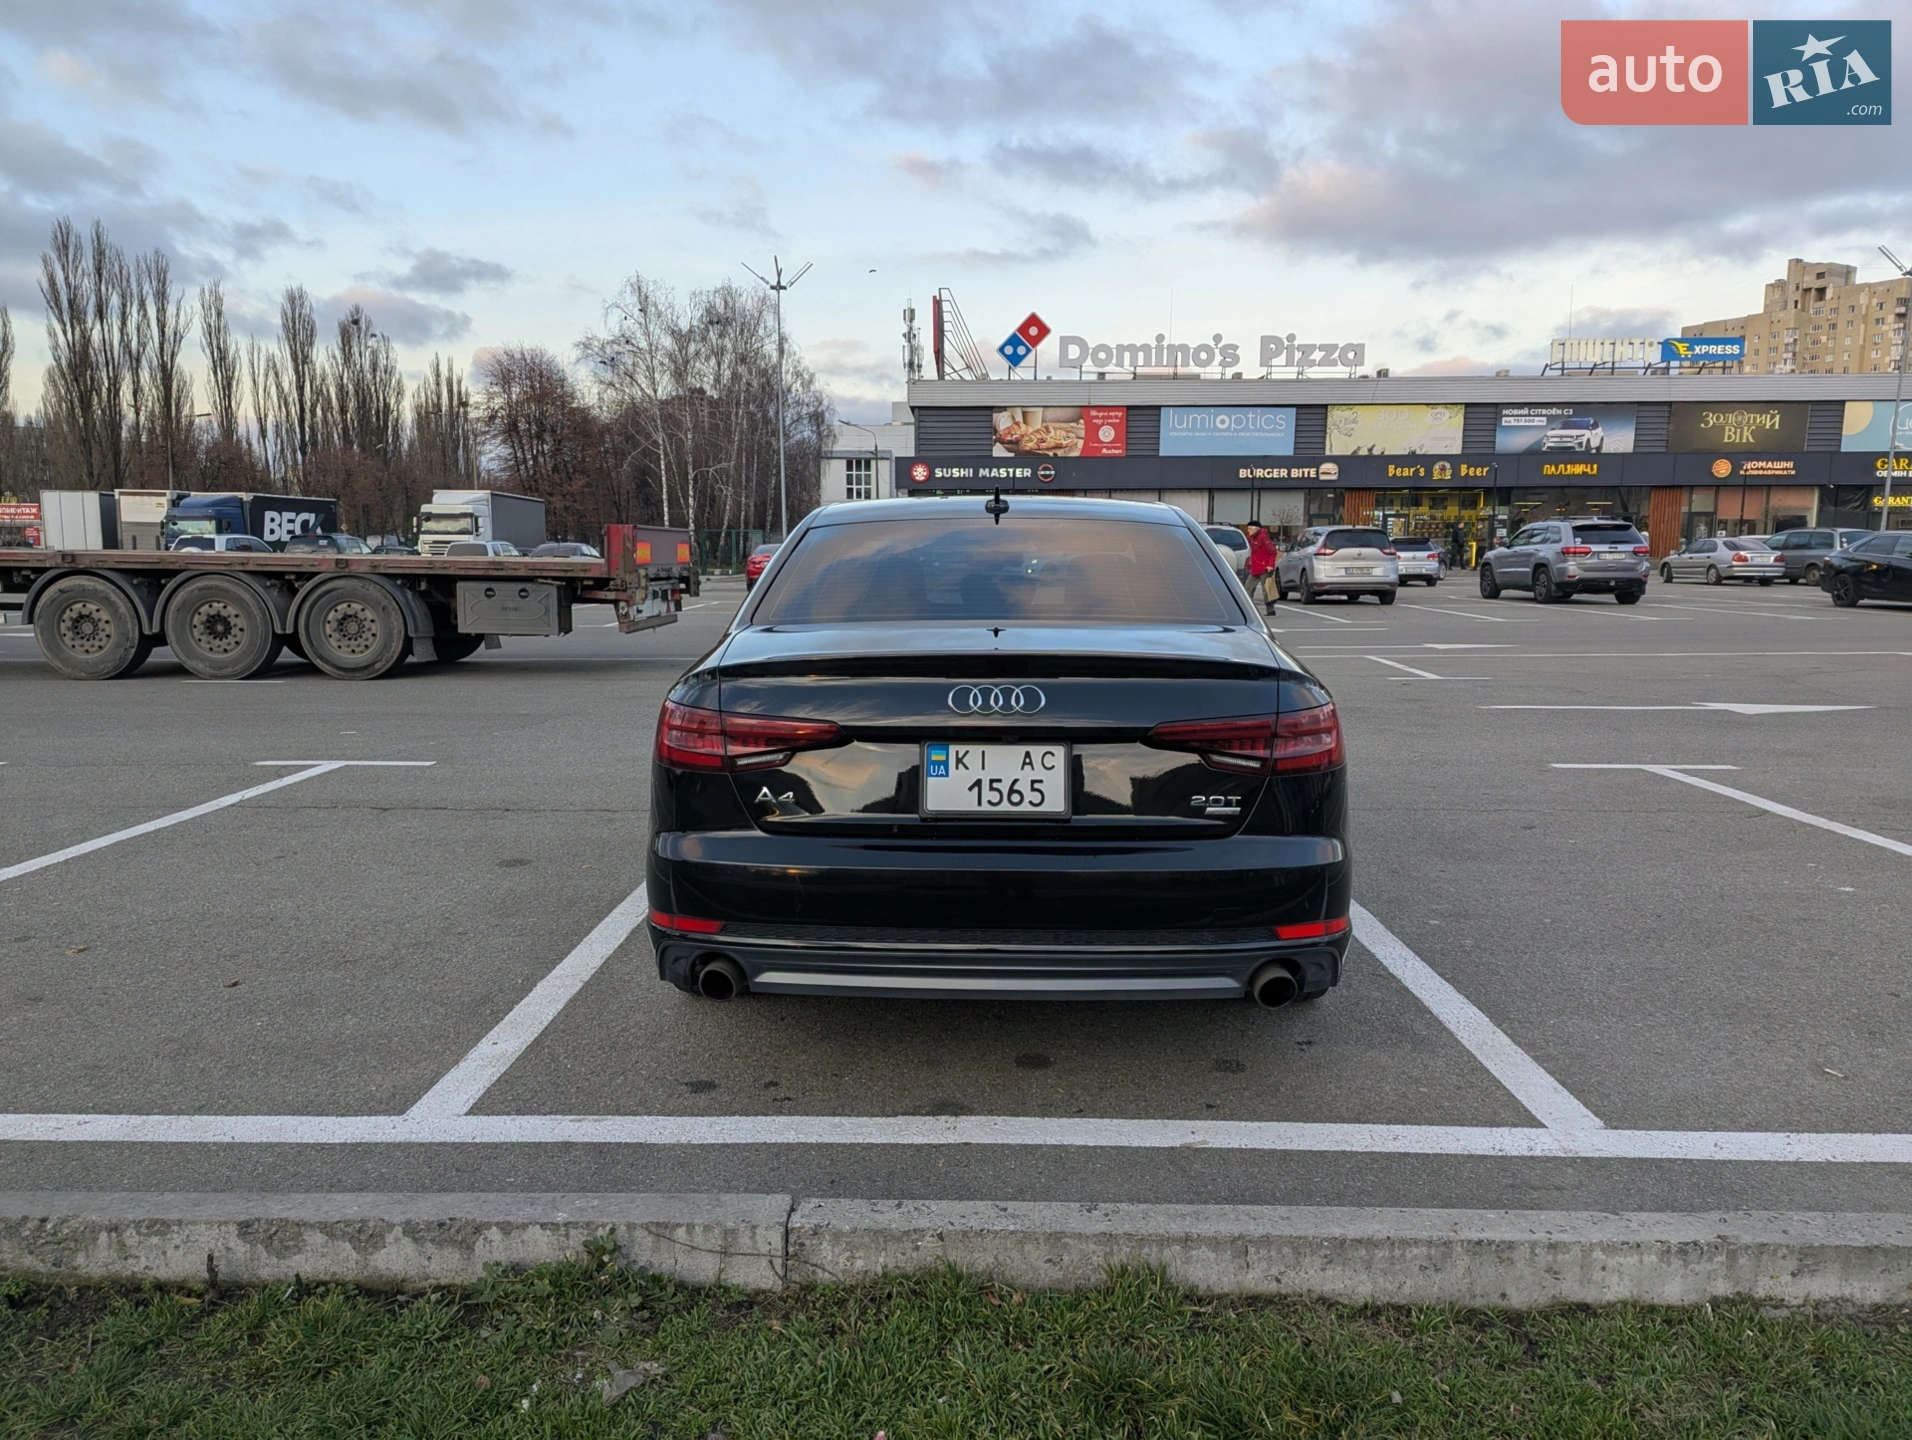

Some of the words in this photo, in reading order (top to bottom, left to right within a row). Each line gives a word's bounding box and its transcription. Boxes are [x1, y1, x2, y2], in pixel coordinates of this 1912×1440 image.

[1058, 332, 1241, 368] Domino's
[1259, 332, 1366, 368] Pizza
[1502, 407, 1529, 415] НОВИЙ
[1169, 408, 1287, 431] lumioptics
[934, 467, 973, 478] SUSHI
[978, 467, 1032, 478] MASTER
[1239, 467, 1288, 479] BURGER
[1290, 467, 1317, 478] BITE
[1388, 464, 1425, 478] Bear's
[1460, 464, 1490, 477] Beer
[955, 749, 986, 771] KI
[1020, 750, 1056, 771] AC
[930, 765, 946, 776] UA
[754, 786, 795, 803] A4
[967, 778, 1046, 807] 1565
[1190, 795, 1242, 807] 2.0T
